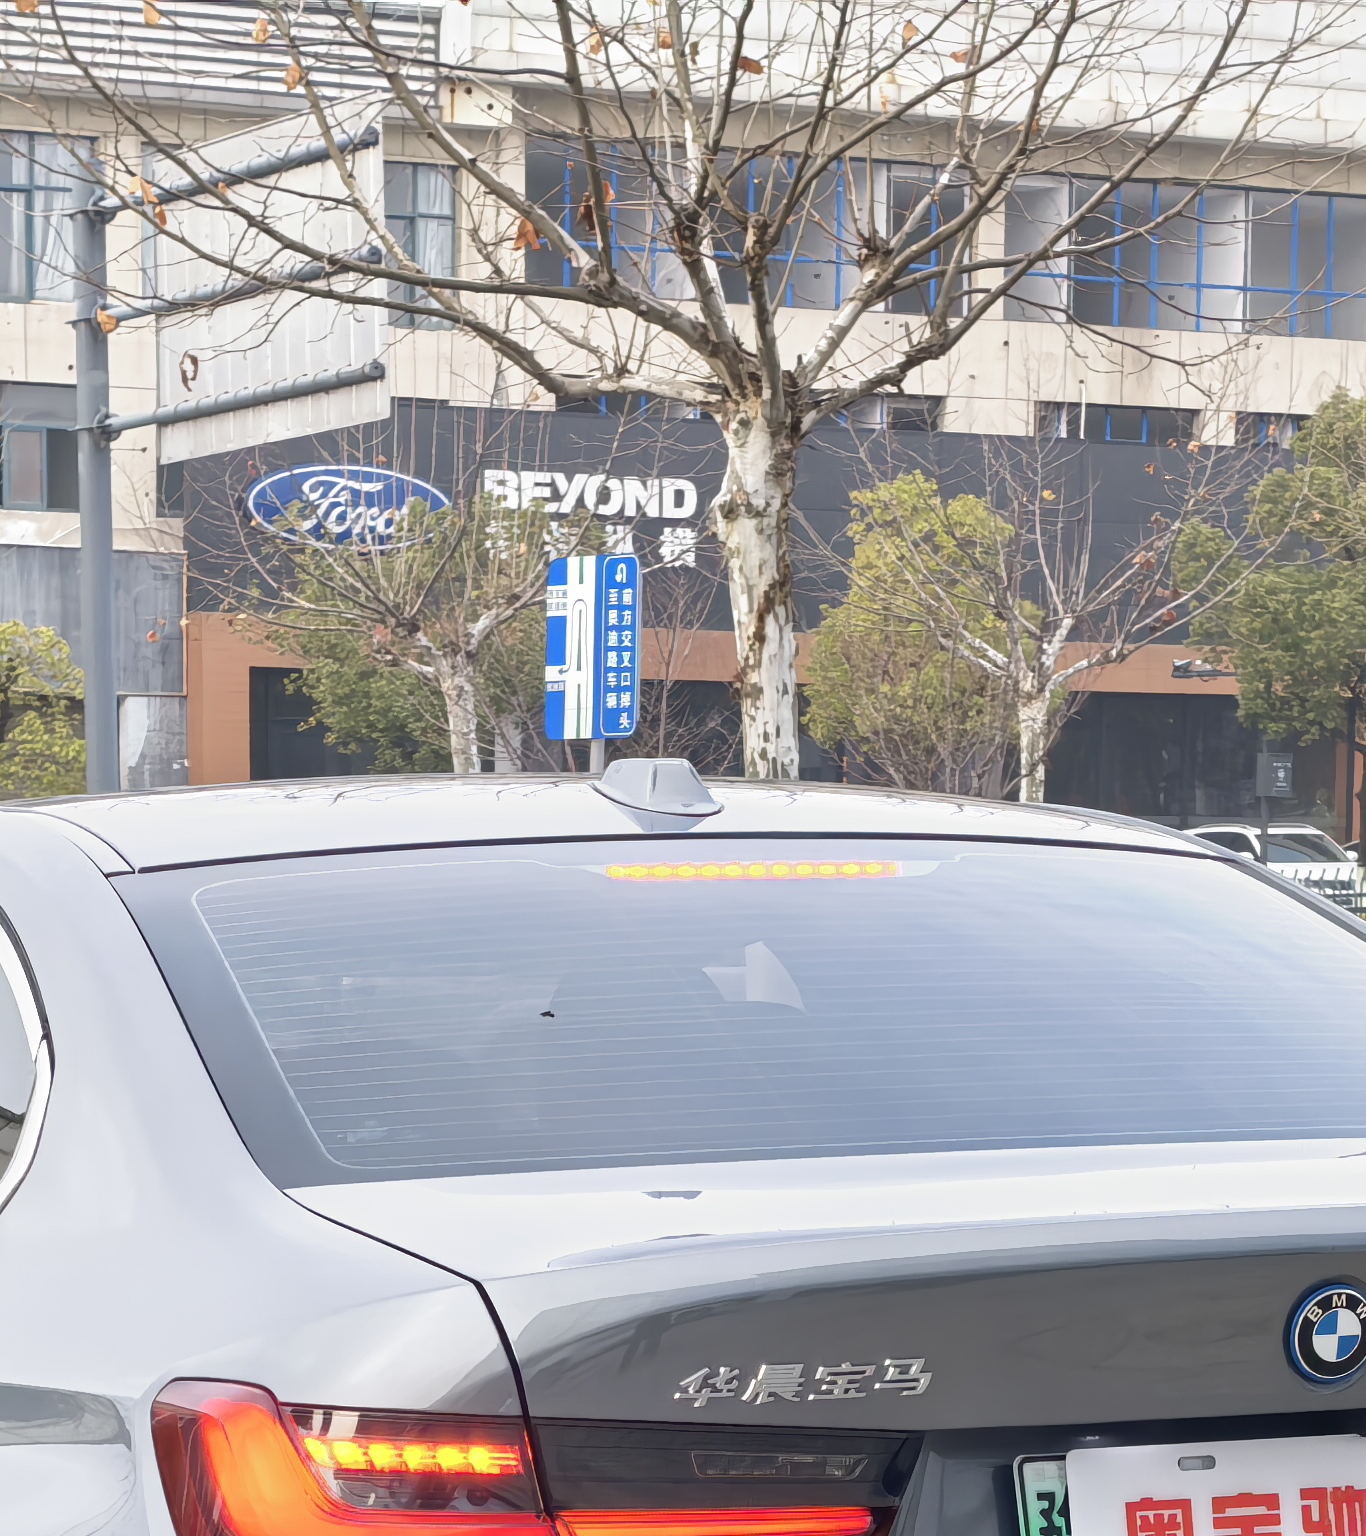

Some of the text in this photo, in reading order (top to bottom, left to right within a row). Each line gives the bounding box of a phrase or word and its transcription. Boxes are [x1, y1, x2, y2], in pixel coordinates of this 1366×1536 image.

[484, 469, 698, 519] BEYOND
[672, 1357, 933, 1408] 华晨宝马
